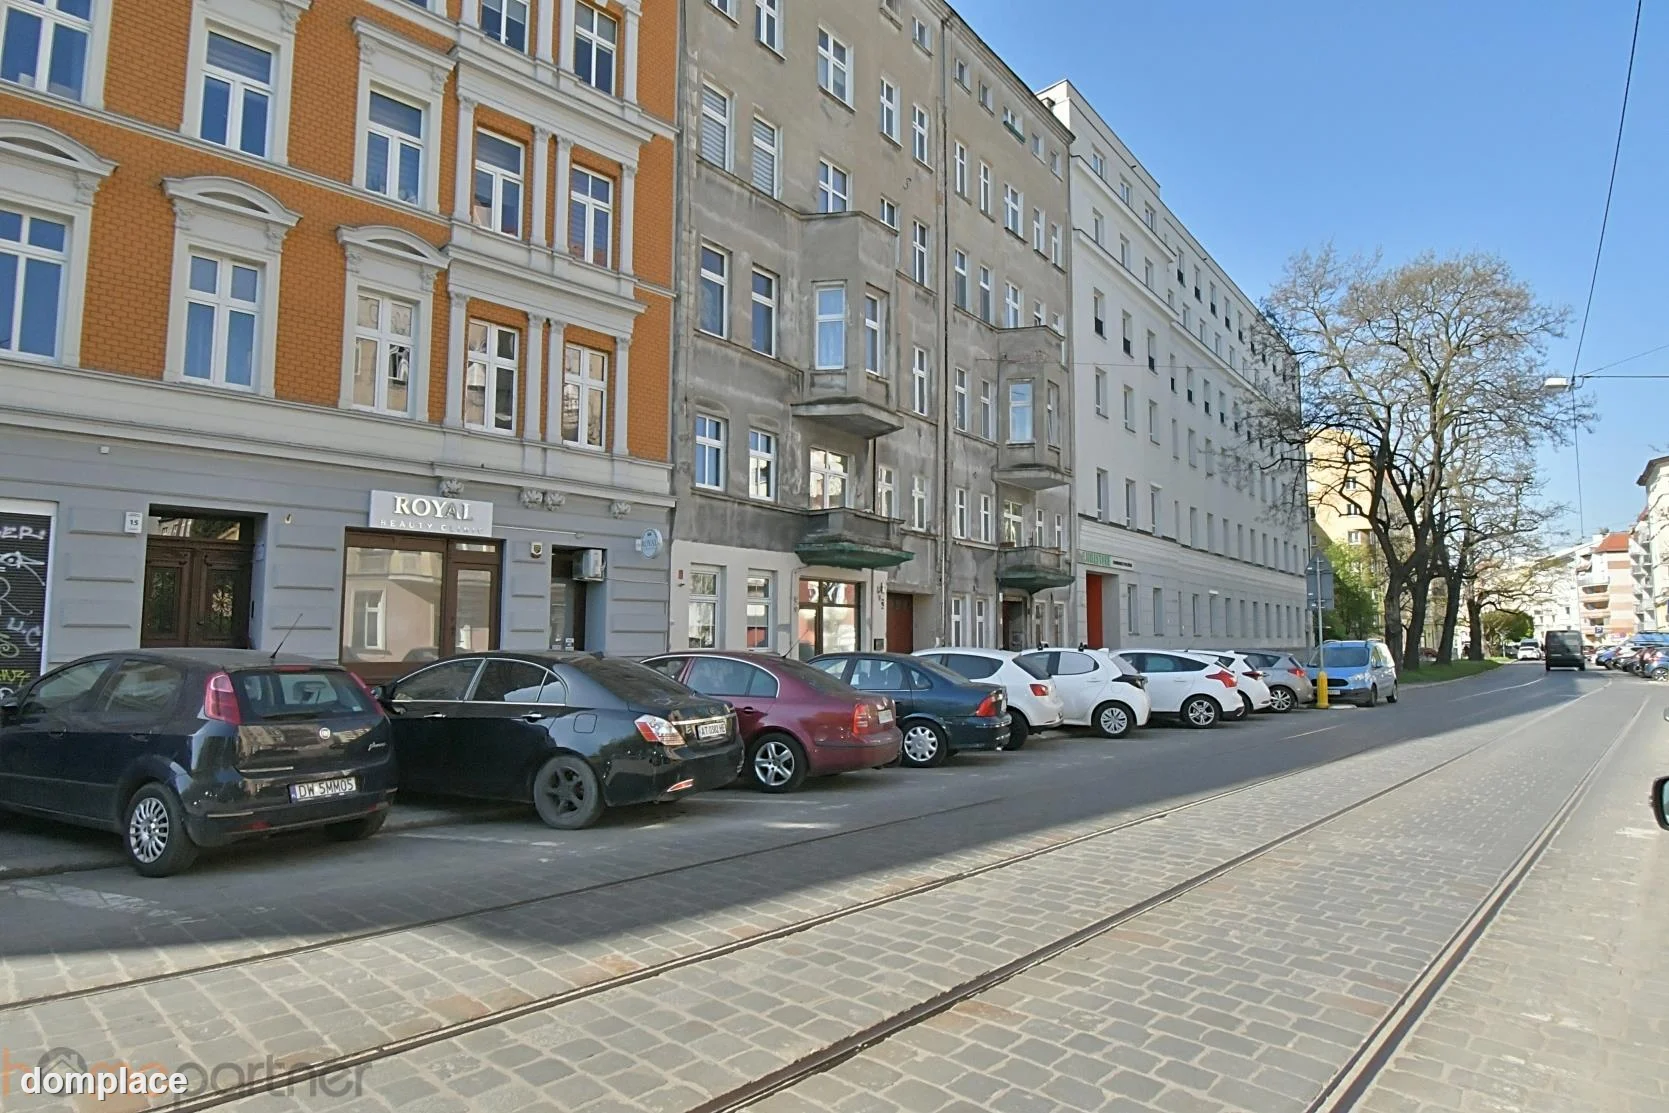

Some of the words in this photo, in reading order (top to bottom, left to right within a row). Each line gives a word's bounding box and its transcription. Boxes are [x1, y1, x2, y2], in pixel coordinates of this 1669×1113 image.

[393, 495, 473, 520] ROYAL
[298, 783, 315, 798] DW
[318, 779, 354, 795] 5MM05
